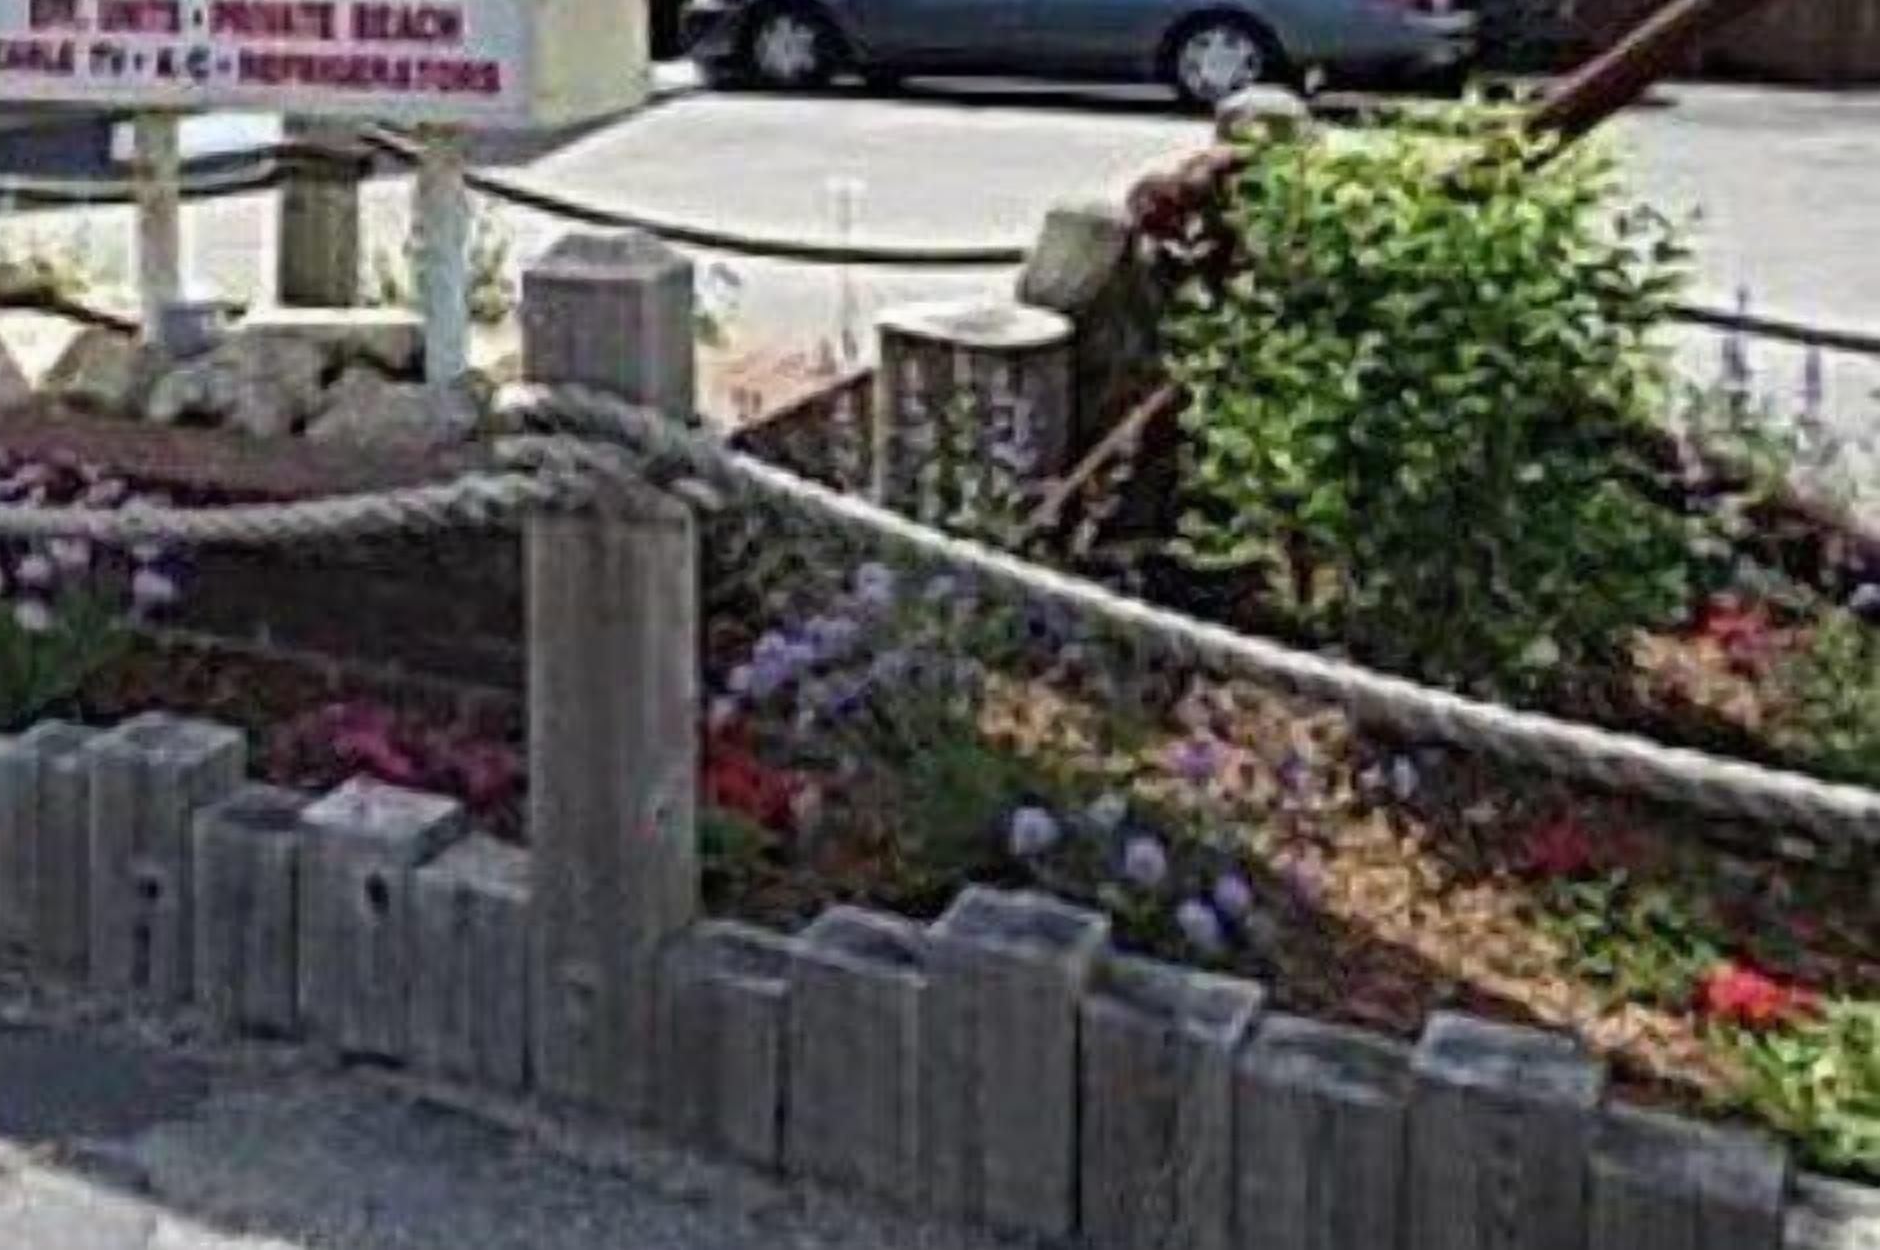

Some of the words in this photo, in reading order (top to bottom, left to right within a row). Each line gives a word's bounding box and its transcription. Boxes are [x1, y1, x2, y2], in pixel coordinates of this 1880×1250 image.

[350, 2, 464, 43] BEACH
[88, 43, 127, 78] TV
[238, 47, 501, 95] REFRIGERATORS
